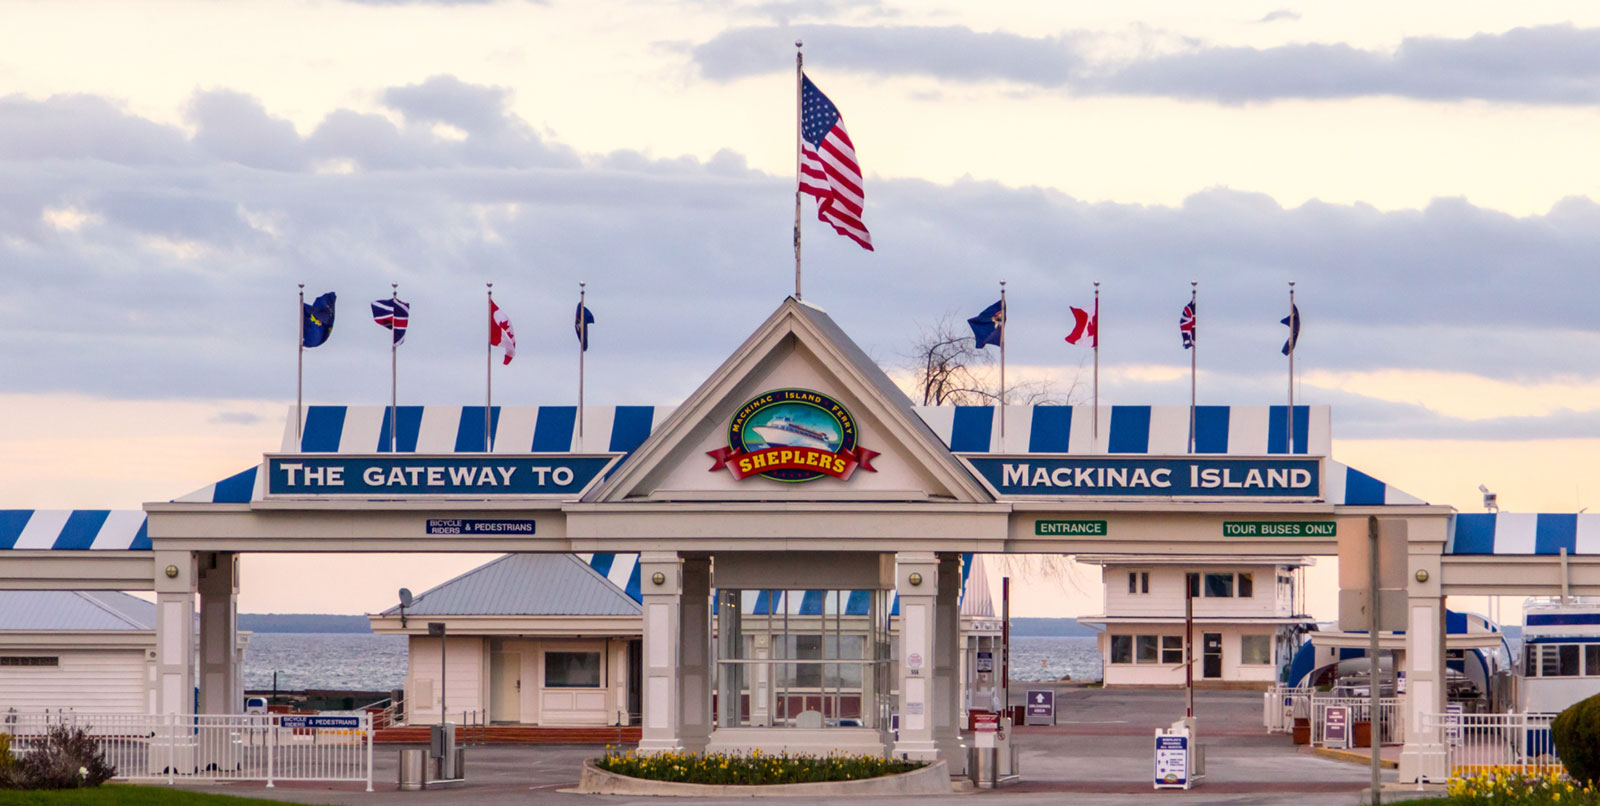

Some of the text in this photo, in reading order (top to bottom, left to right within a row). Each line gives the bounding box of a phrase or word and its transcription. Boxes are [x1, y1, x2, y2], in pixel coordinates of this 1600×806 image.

[732, 392, 853, 434] MACKINAC ISLAND FERRY
[739, 450, 846, 473] SHEPLER'S
[280, 463, 574, 486] THE GATEWAY TO
[1002, 463, 1312, 488] MACKINAC ISLAND
[465, 523, 471, 531] &
[474, 523, 532, 531] PEDESTRIANS
[1041, 523, 1102, 533] ENTRANCE
[1226, 524, 1334, 534] TOUR BUSES ONLY
